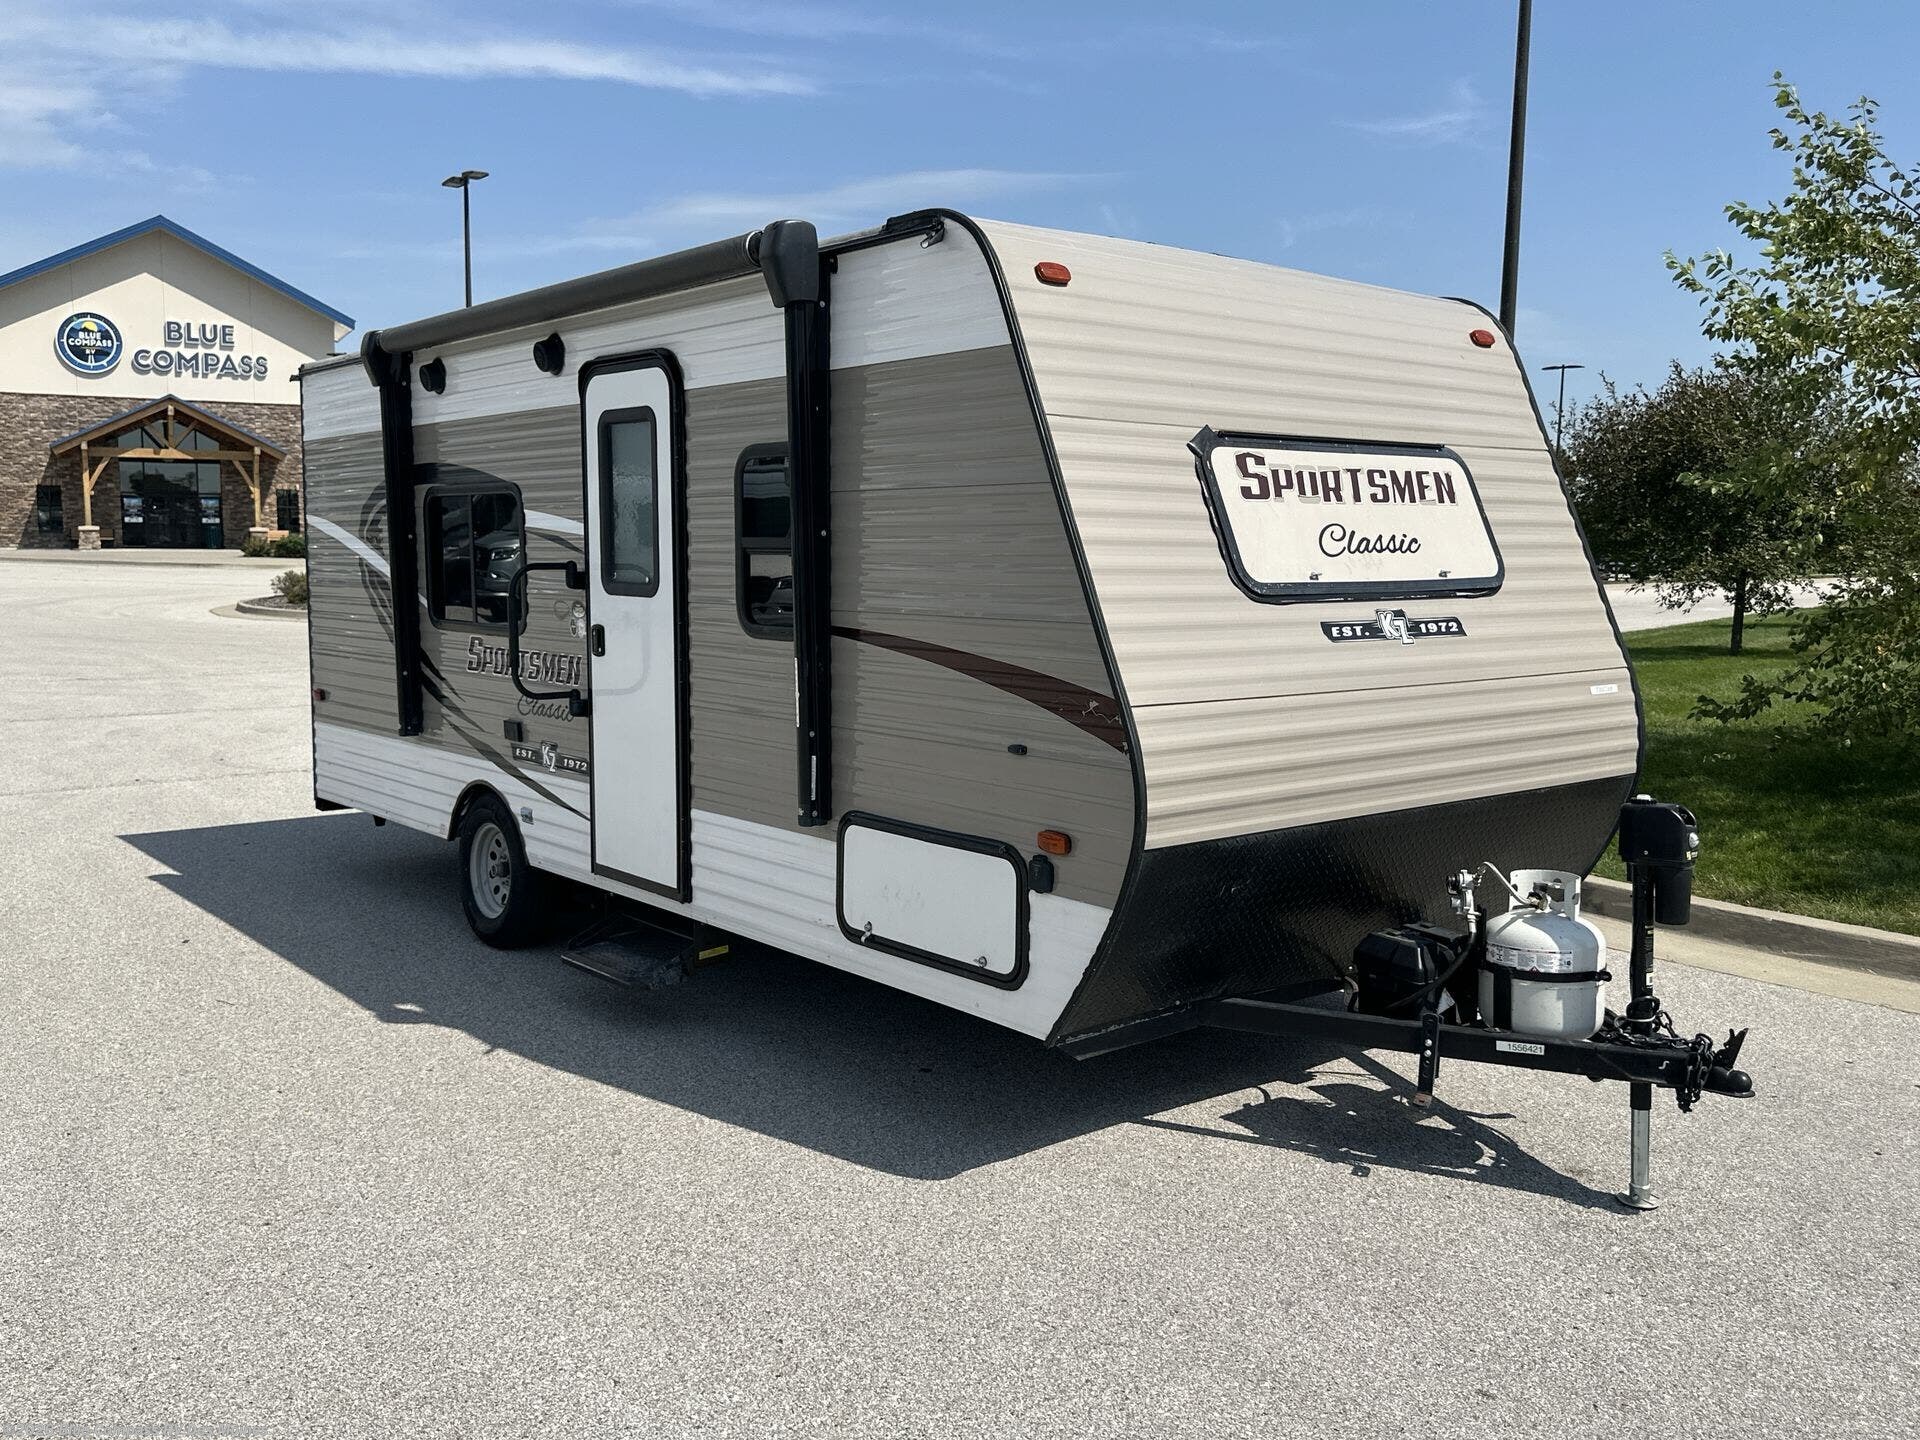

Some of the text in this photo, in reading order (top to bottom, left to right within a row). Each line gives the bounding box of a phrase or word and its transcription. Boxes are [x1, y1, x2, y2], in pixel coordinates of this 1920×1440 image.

[68, 338, 113, 347] COMPASS
[78, 331, 101, 340] BLUE
[165, 321, 234, 346] BLUE
[132, 349, 269, 377] COMPASS
[1234, 451, 1458, 505] SPORTSMEN
[1319, 523, 1421, 557] Classic
[1331, 611, 1459, 645] EST. KZ 1972
[515, 745, 588, 773] EST. KZ 1972
[1507, 1043, 1543, 1054] 1556421
